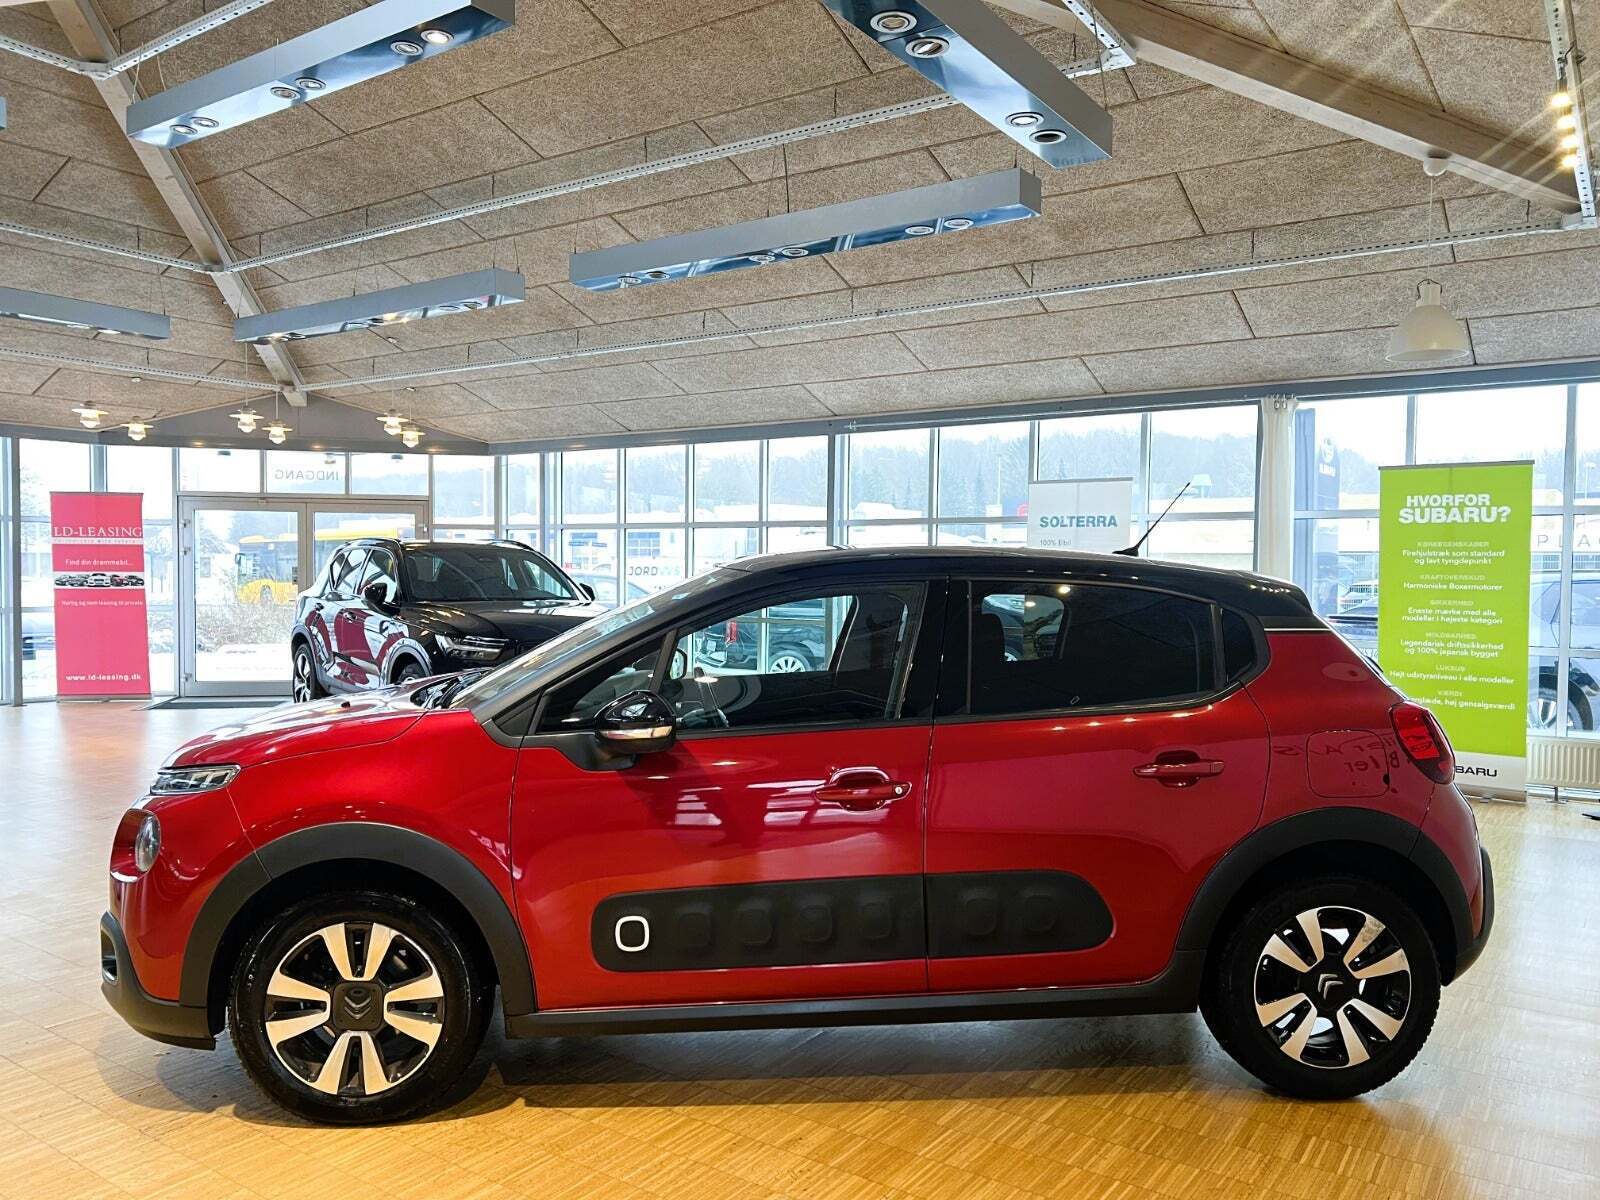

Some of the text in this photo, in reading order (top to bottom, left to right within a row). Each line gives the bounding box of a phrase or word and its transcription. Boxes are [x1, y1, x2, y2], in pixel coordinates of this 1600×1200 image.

[1406, 493, 1491, 507] HVORFOR
[1398, 506, 1512, 524] SUBARU?
[1039, 514, 1118, 528] SOLTERRA
[53, 526, 142, 537] LD-LEASING
[1470, 549, 1505, 557] standard
[1442, 557, 1492, 566] tyngdepunkt
[1403, 581, 1503, 591] Harmoniske Boxermotorer
[1408, 606, 1433, 614] Eneste
[1463, 608, 1481, 616] med
[1482, 608, 1497, 617] alle
[1402, 614, 1434, 622] modeller
[1470, 616, 1503, 626] kategori
[1400, 639, 1445, 648] Legendarisk
[1417, 647, 1438, 655] 100%
[1439, 649, 1469, 657] japansk
[1470, 650, 1499, 659] bygget
[1464, 674, 1478, 682] alle
[1479, 676, 1515, 684] modeller
[1455, 765, 1498, 777] BARU
